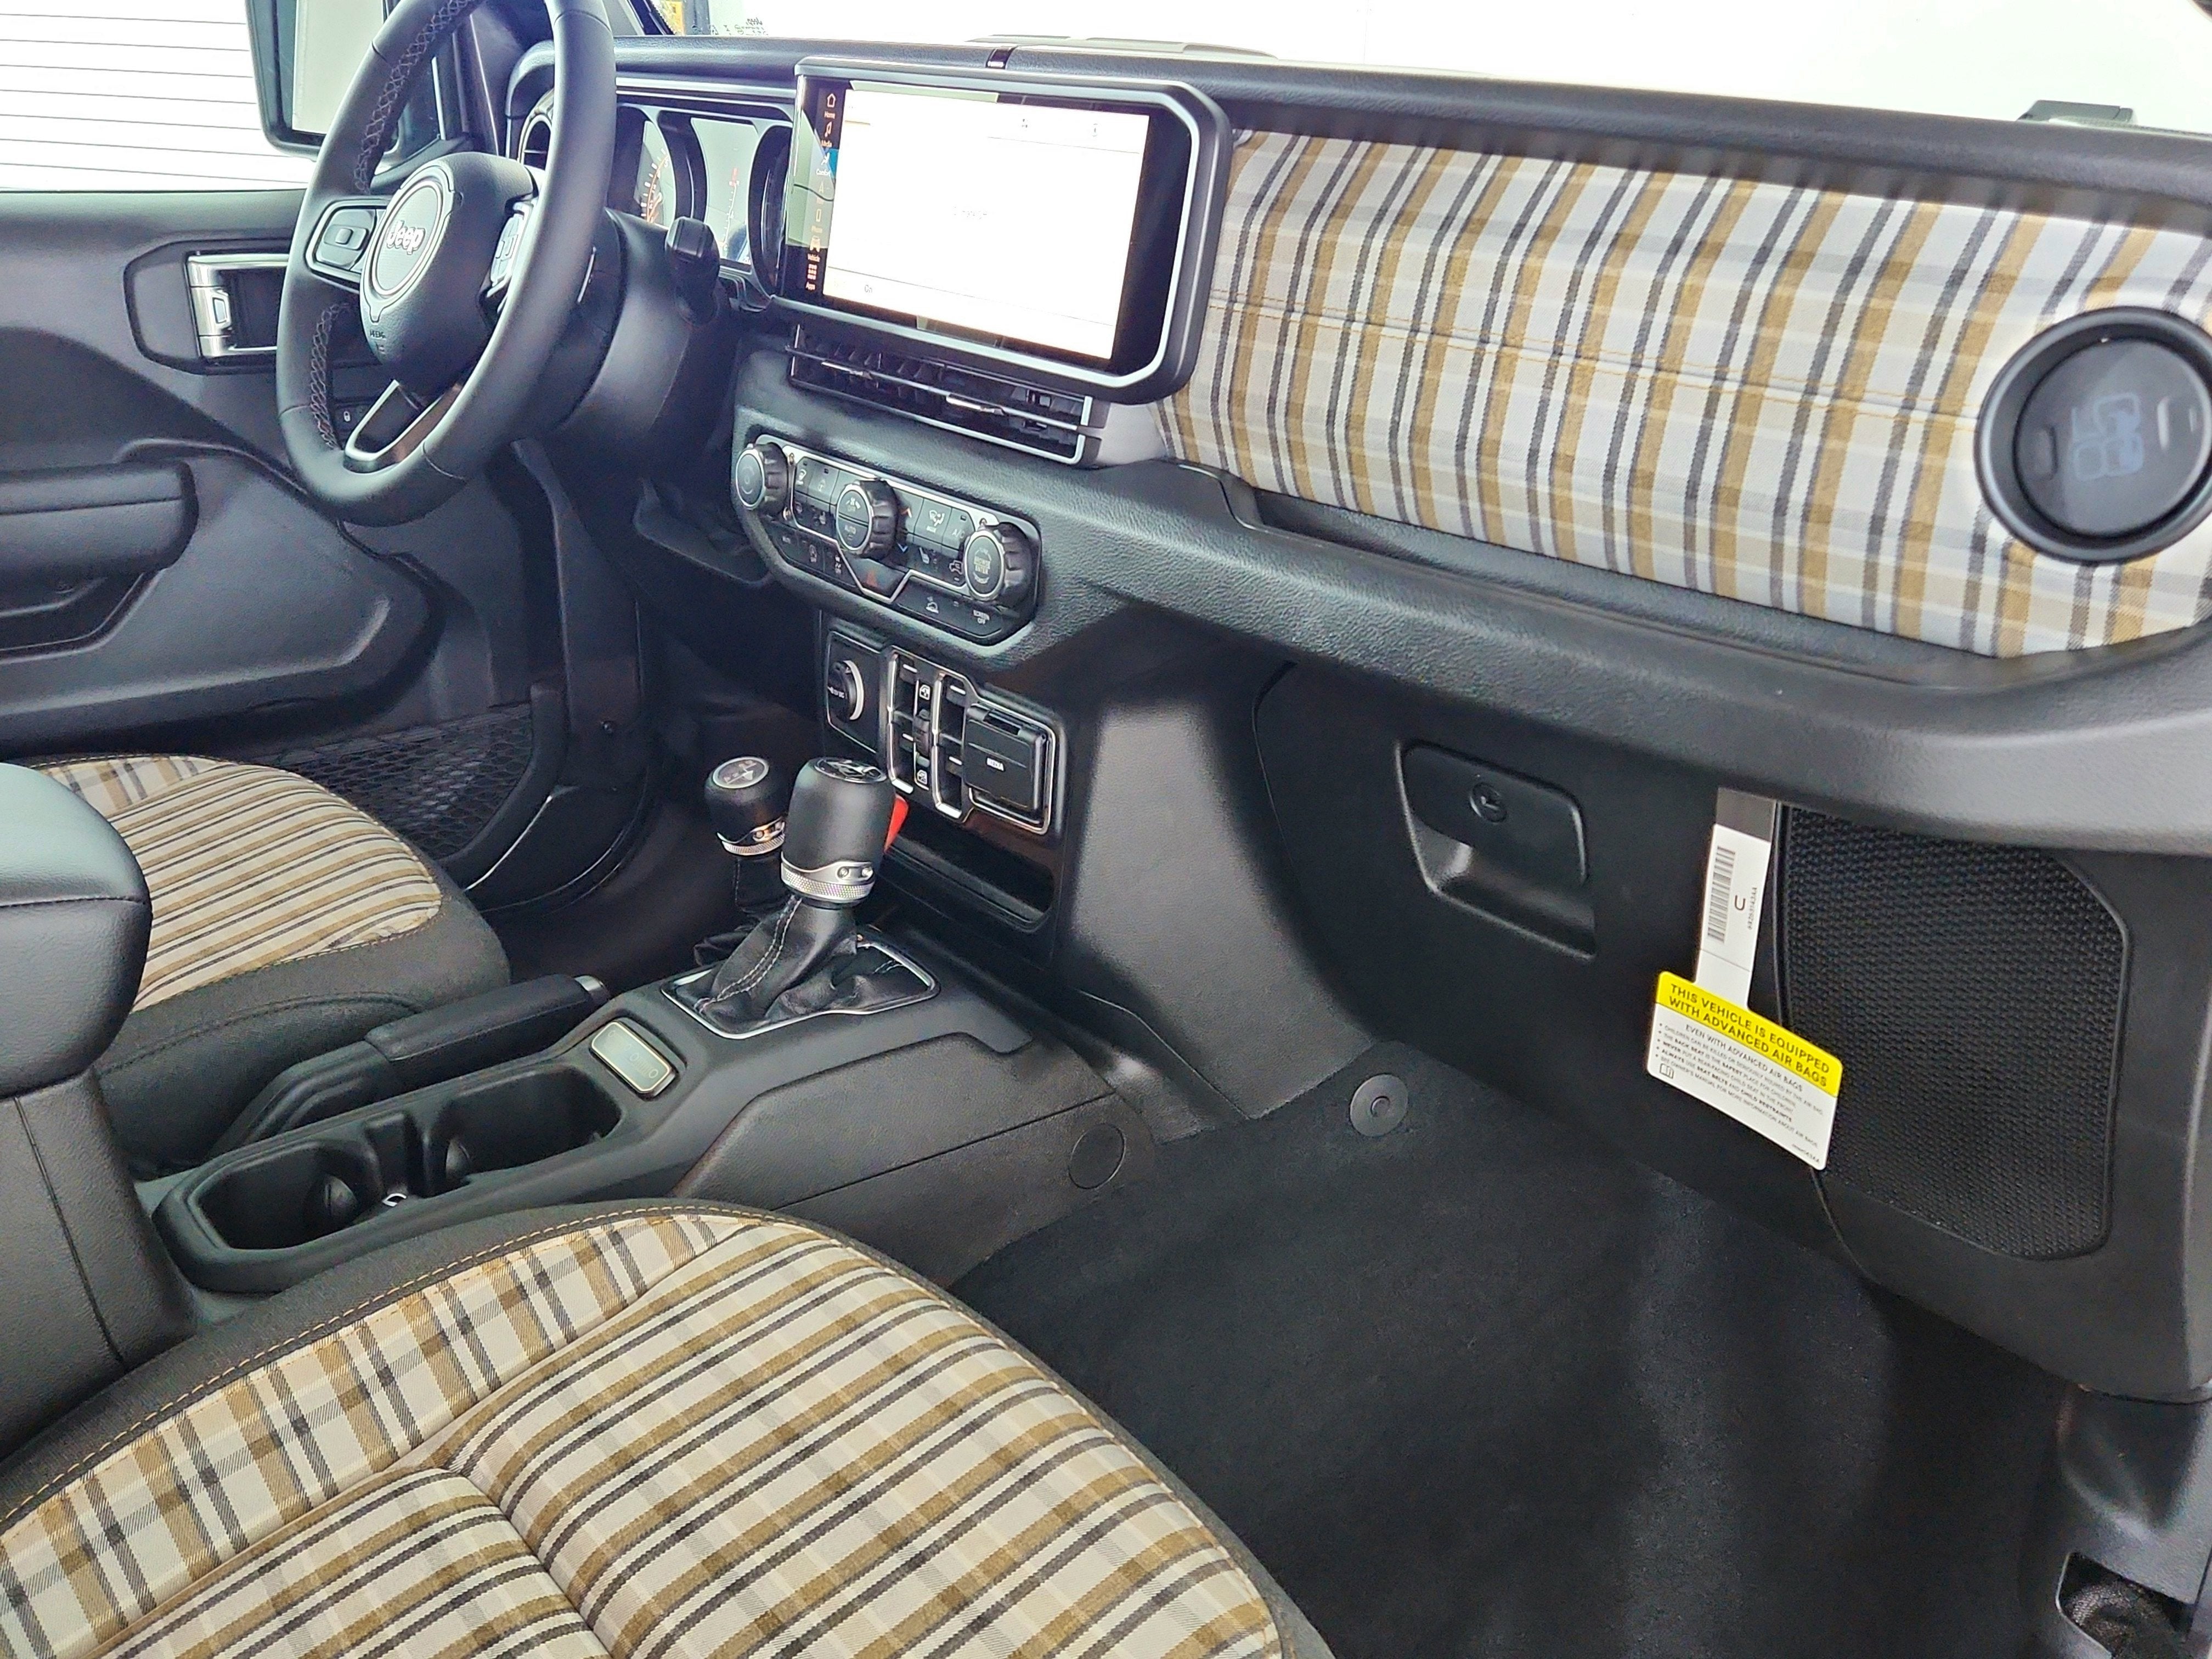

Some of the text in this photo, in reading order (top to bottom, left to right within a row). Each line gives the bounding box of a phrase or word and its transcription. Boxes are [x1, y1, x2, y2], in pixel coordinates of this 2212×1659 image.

[386, 221, 426, 255] Jeep
[844, 524, 856, 534] AUTO
[951, 528, 965, 539] A/C
[974, 566, 989, 575] ENTER
[973, 610, 990, 620] SCREEN
[1735, 895, 1745, 910] U
[1669, 983, 1830, 1075] THIS VEHICLE IS EQUIPPED
[1662, 1040, 1681, 1053] NEVER
[1668, 995, 1827, 1088] WITH ADVANCED AIR BAGS
[1661, 1047, 1685, 1063] ALWAYS
[1685, 1023, 1803, 1092] EVEN WITH ADVANCED AIR BAGS
